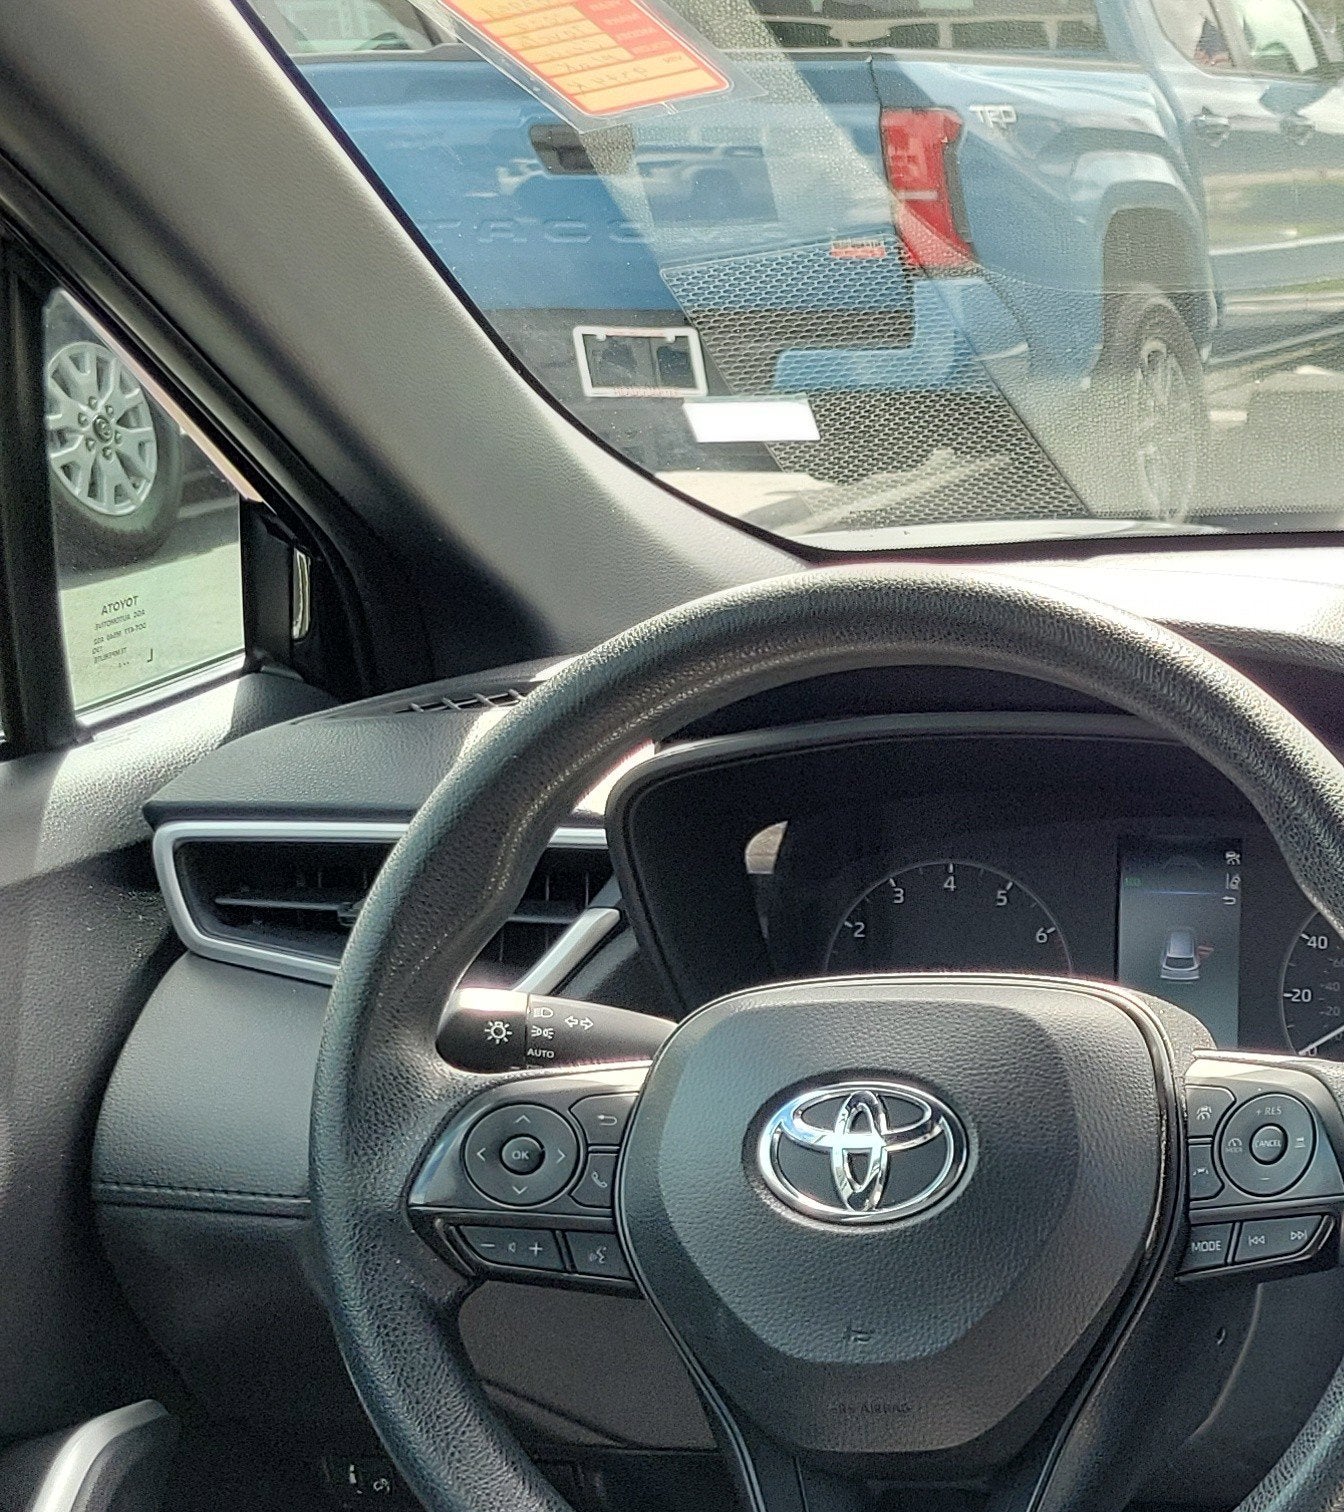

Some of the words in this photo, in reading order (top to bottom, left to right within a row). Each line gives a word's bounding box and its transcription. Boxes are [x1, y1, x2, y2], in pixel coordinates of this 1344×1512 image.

[943, 875, 957, 892] 4
[893, 888, 905, 904] 3
[995, 890, 1008, 907] 5
[853, 921, 866, 938] 2
[1035, 927, 1048, 943] 6
[1307, 936, 1328, 950] 40
[1325, 982, 1341, 992] 40
[1291, 988, 1312, 1003] 20
[1326, 1006, 1341, 1016] 20
[527, 1048, 555, 1059] AUTO
[1265, 1106, 1282, 1116] RES
[1255, 1139, 1282, 1148] CANCEL
[512, 1150, 530, 1160] OK
[1191, 1240, 1222, 1252] MODE
